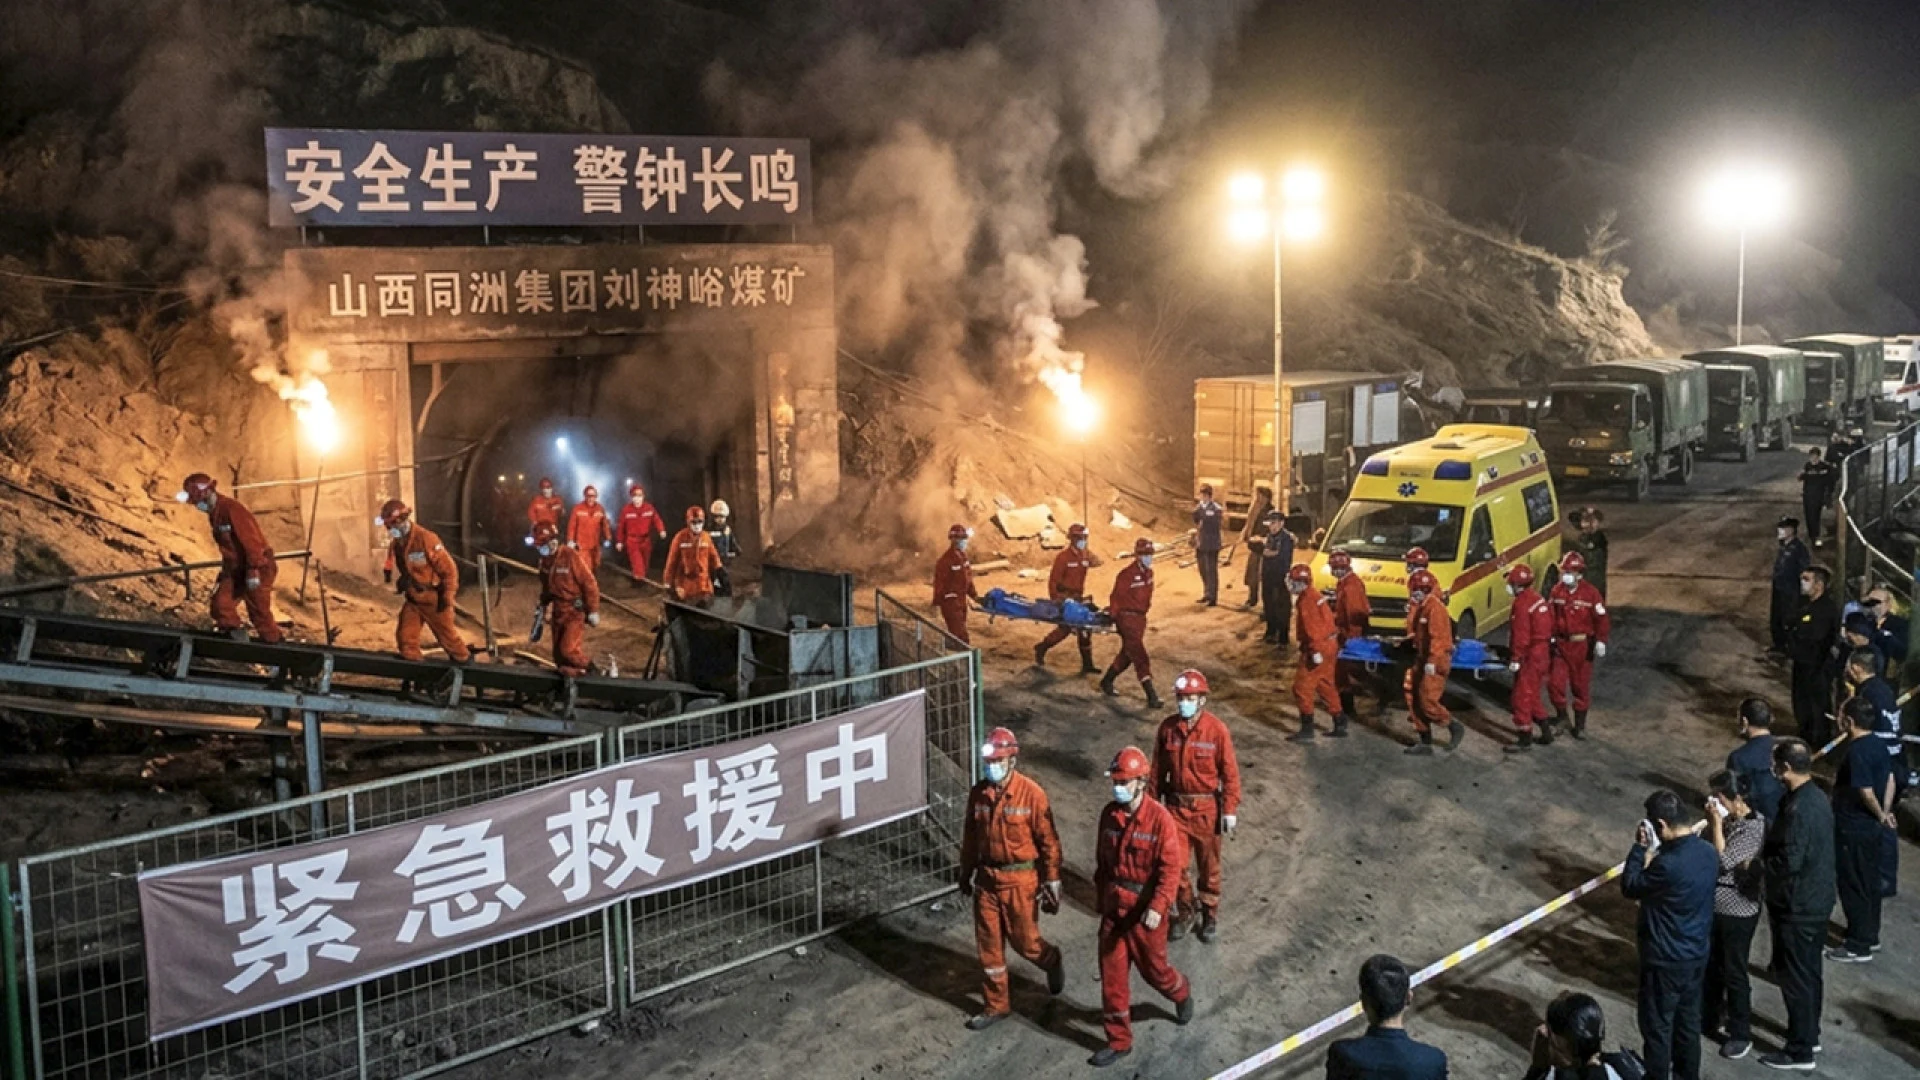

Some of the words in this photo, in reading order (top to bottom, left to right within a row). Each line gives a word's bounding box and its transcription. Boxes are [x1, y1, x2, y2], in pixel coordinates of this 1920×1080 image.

[285, 140, 538, 213] 安全生产
[573, 144, 799, 214] 警钟长鸣
[329, 265, 805, 318] 山西同洲集团刘神峪煤矿
[221, 722, 888, 994] 紧急救援中
